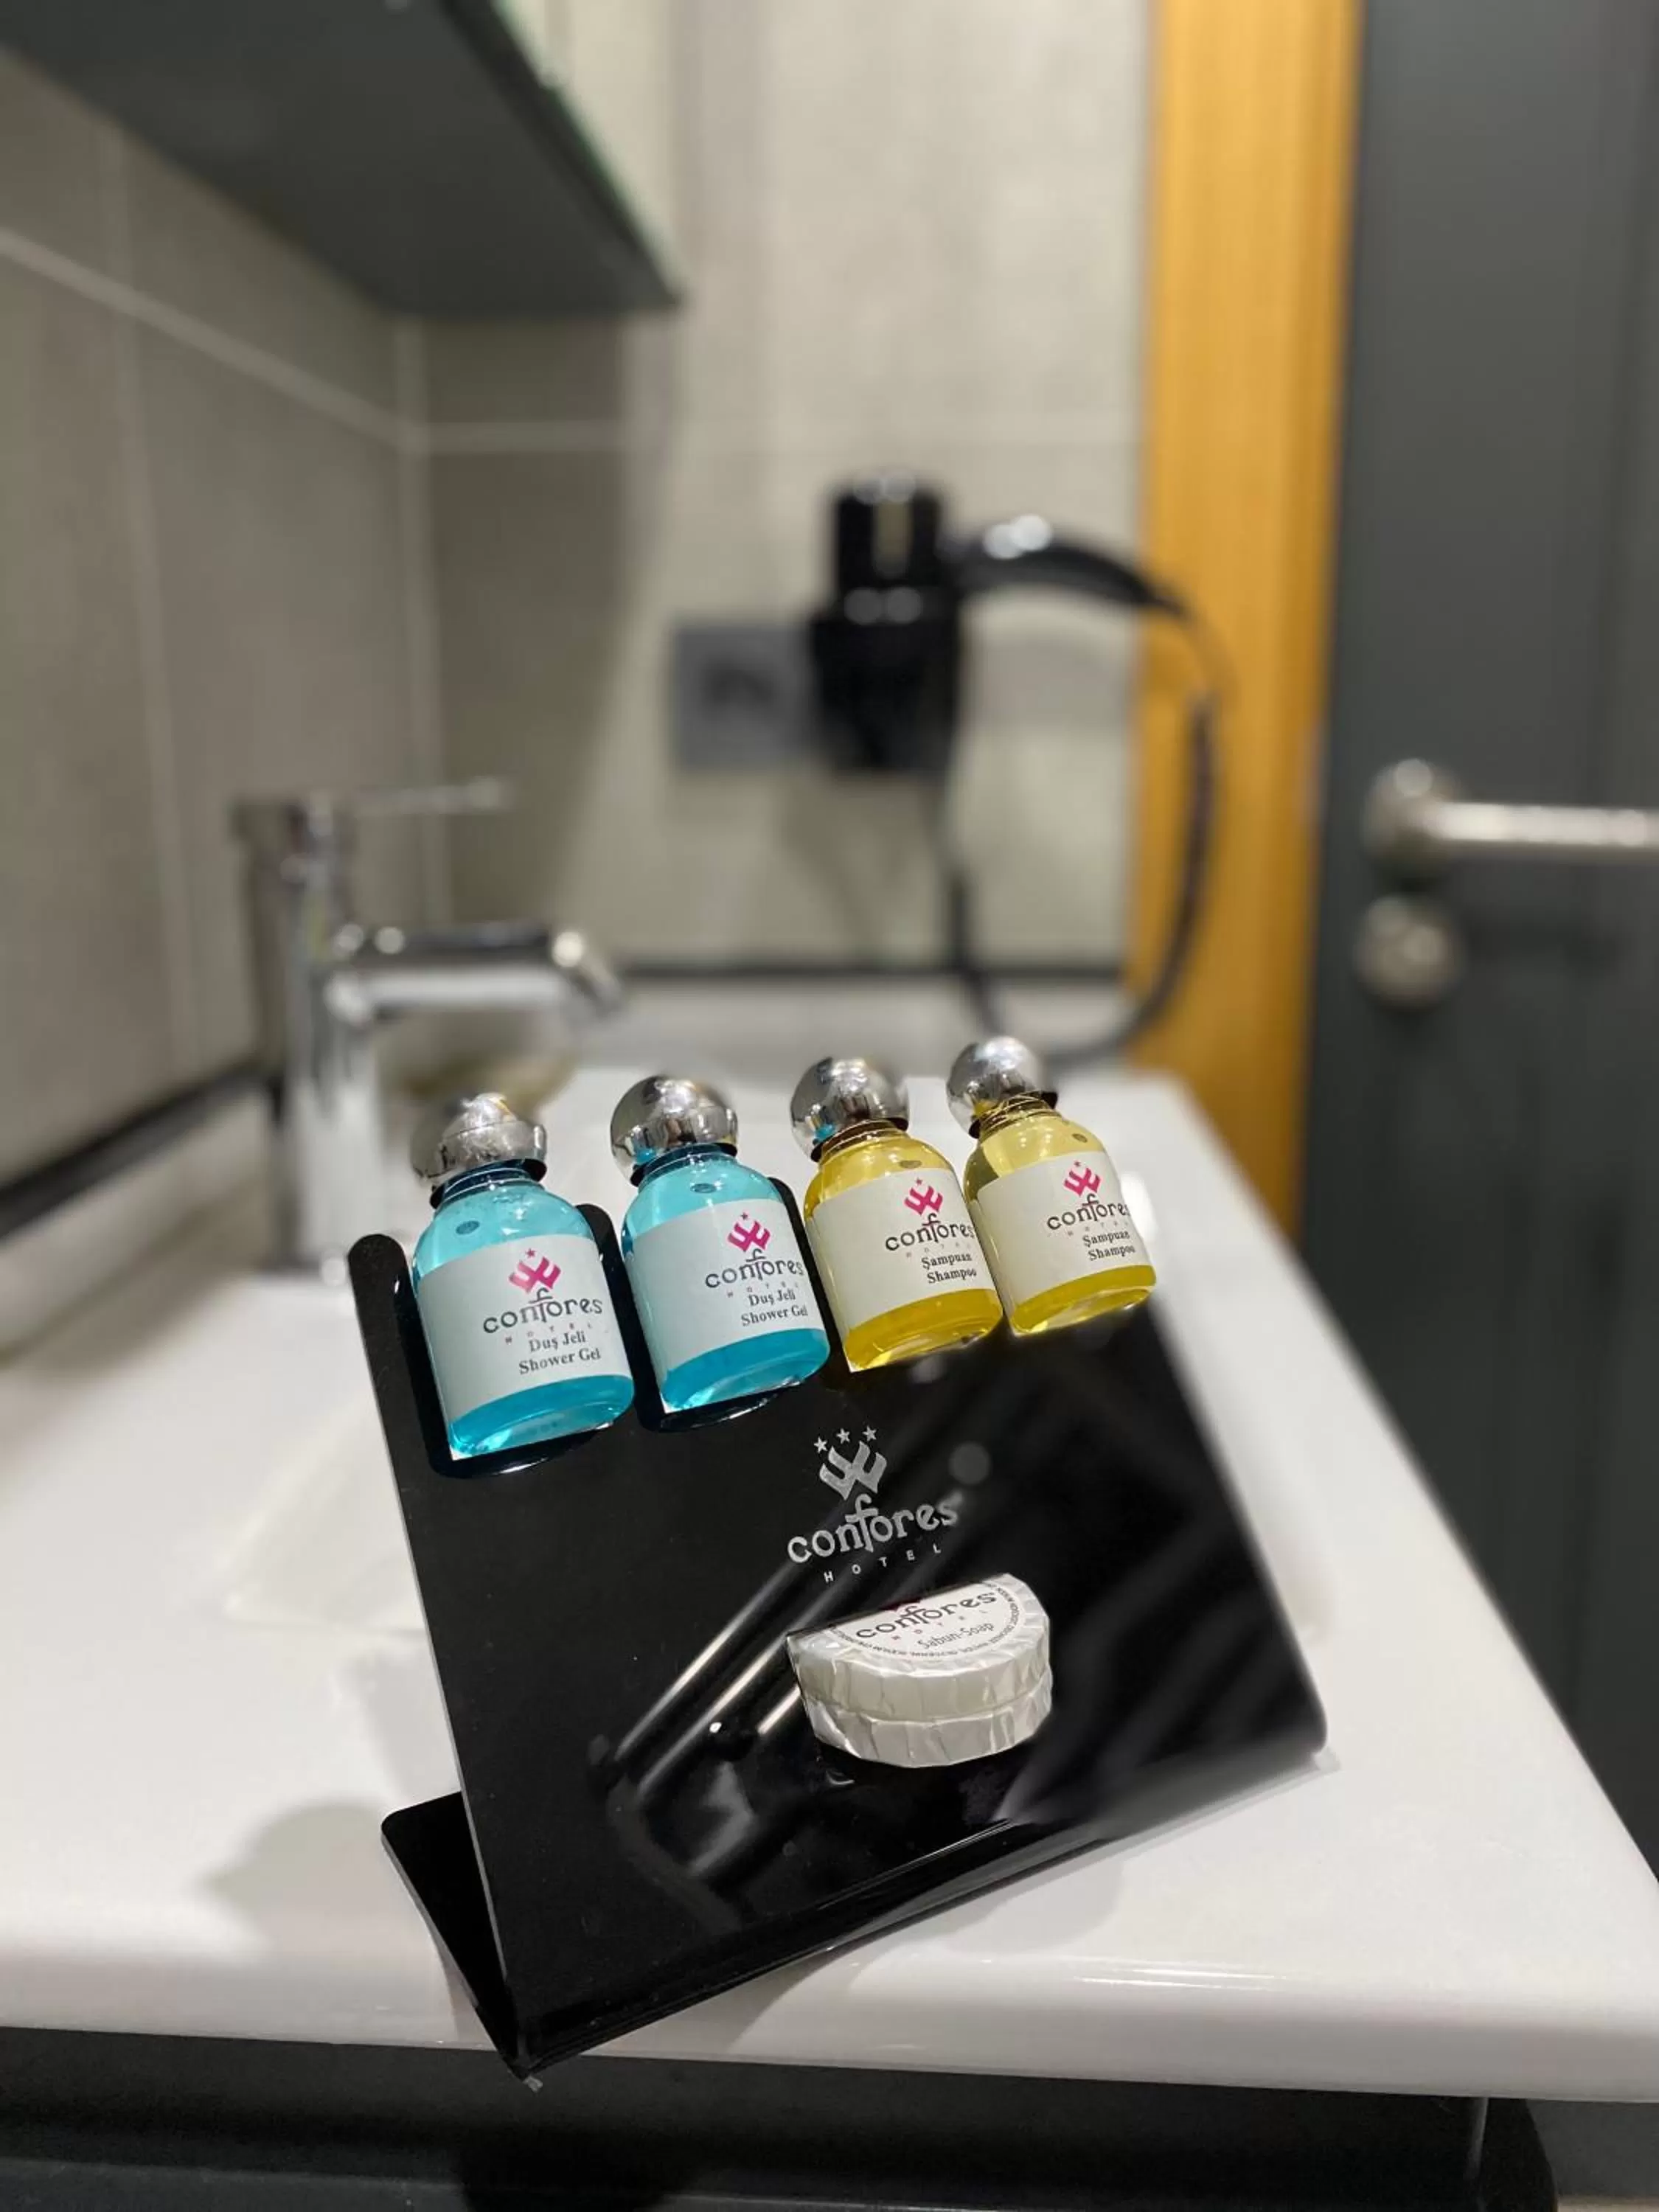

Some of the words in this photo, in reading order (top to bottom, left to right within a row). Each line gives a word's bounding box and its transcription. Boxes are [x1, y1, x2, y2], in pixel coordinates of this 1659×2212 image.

[885, 1212, 975, 1251] confores
[705, 1248, 804, 1288] confores
[1088, 1245, 1136, 1262] Shampoo
[927, 1267, 977, 1284] Shampoo
[483, 1287, 603, 1334] confores
[748, 1292, 775, 1307] Duş
[741, 1309, 788, 1326] Shower
[529, 1335, 559, 1352] Duş
[563, 1331, 586, 1346] Jeli
[518, 1352, 576, 1374] Shower
[579, 1348, 602, 1361] Gel
[787, 1493, 959, 1563] confores
[824, 1543, 942, 1583] HOTEL
[856, 1593, 996, 1638] confores
